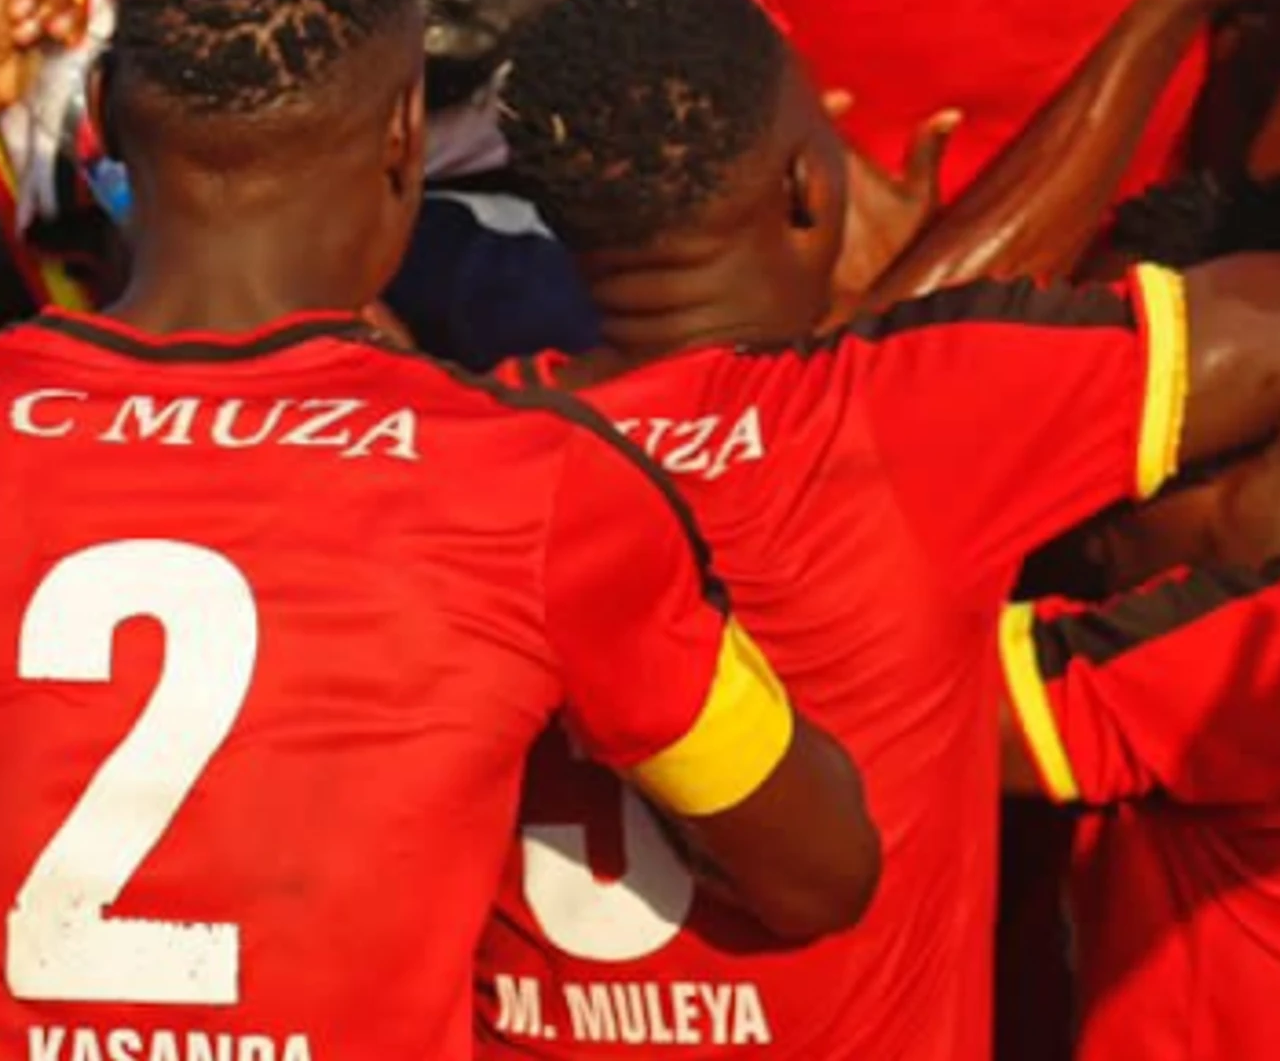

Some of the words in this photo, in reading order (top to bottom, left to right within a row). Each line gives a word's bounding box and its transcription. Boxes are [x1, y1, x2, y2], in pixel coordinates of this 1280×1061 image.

[9, 388, 87, 437] C
[97, 395, 420, 460] MUZA
[6, 539, 258, 1005] 2
[495, 973, 556, 1040] M.
[563, 981, 772, 1044] MULEYA
